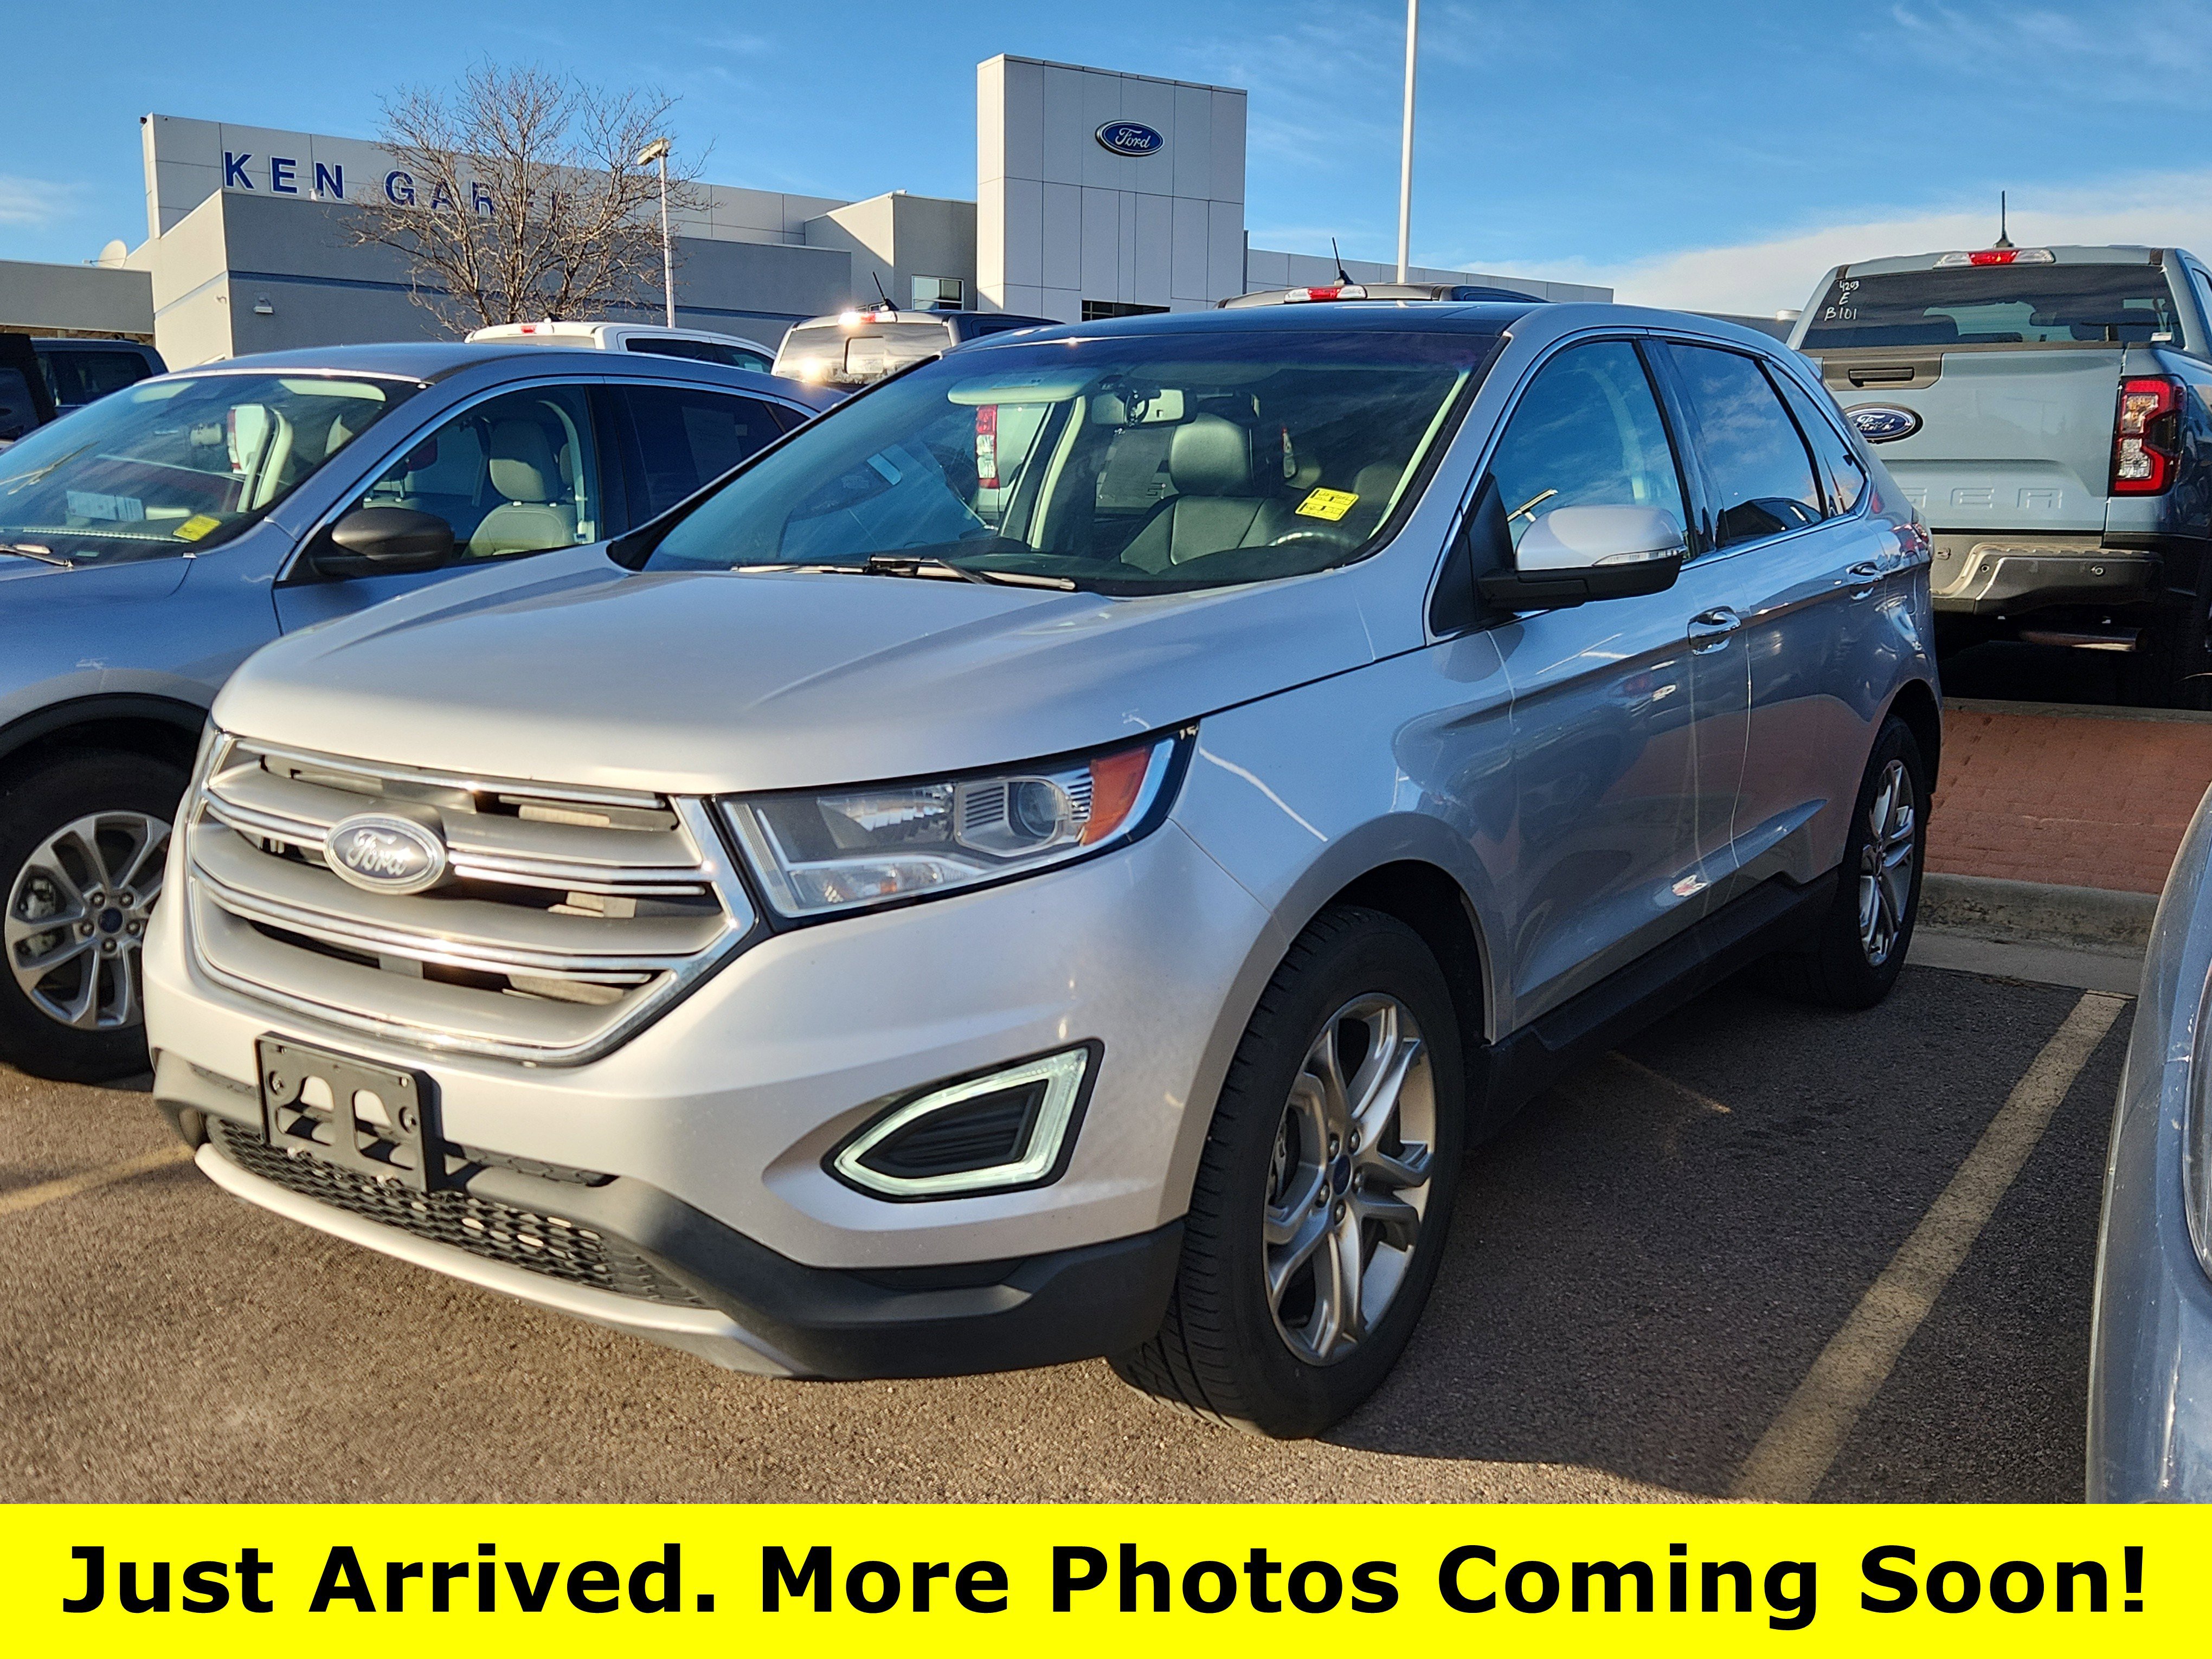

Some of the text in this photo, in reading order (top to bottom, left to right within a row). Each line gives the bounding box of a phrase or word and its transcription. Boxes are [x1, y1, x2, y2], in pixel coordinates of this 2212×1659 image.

[1115, 127, 1151, 148] Ford
[223, 150, 345, 200] KEN
[1838, 292, 1850, 305] E
[345, 828, 411, 877] Ford
